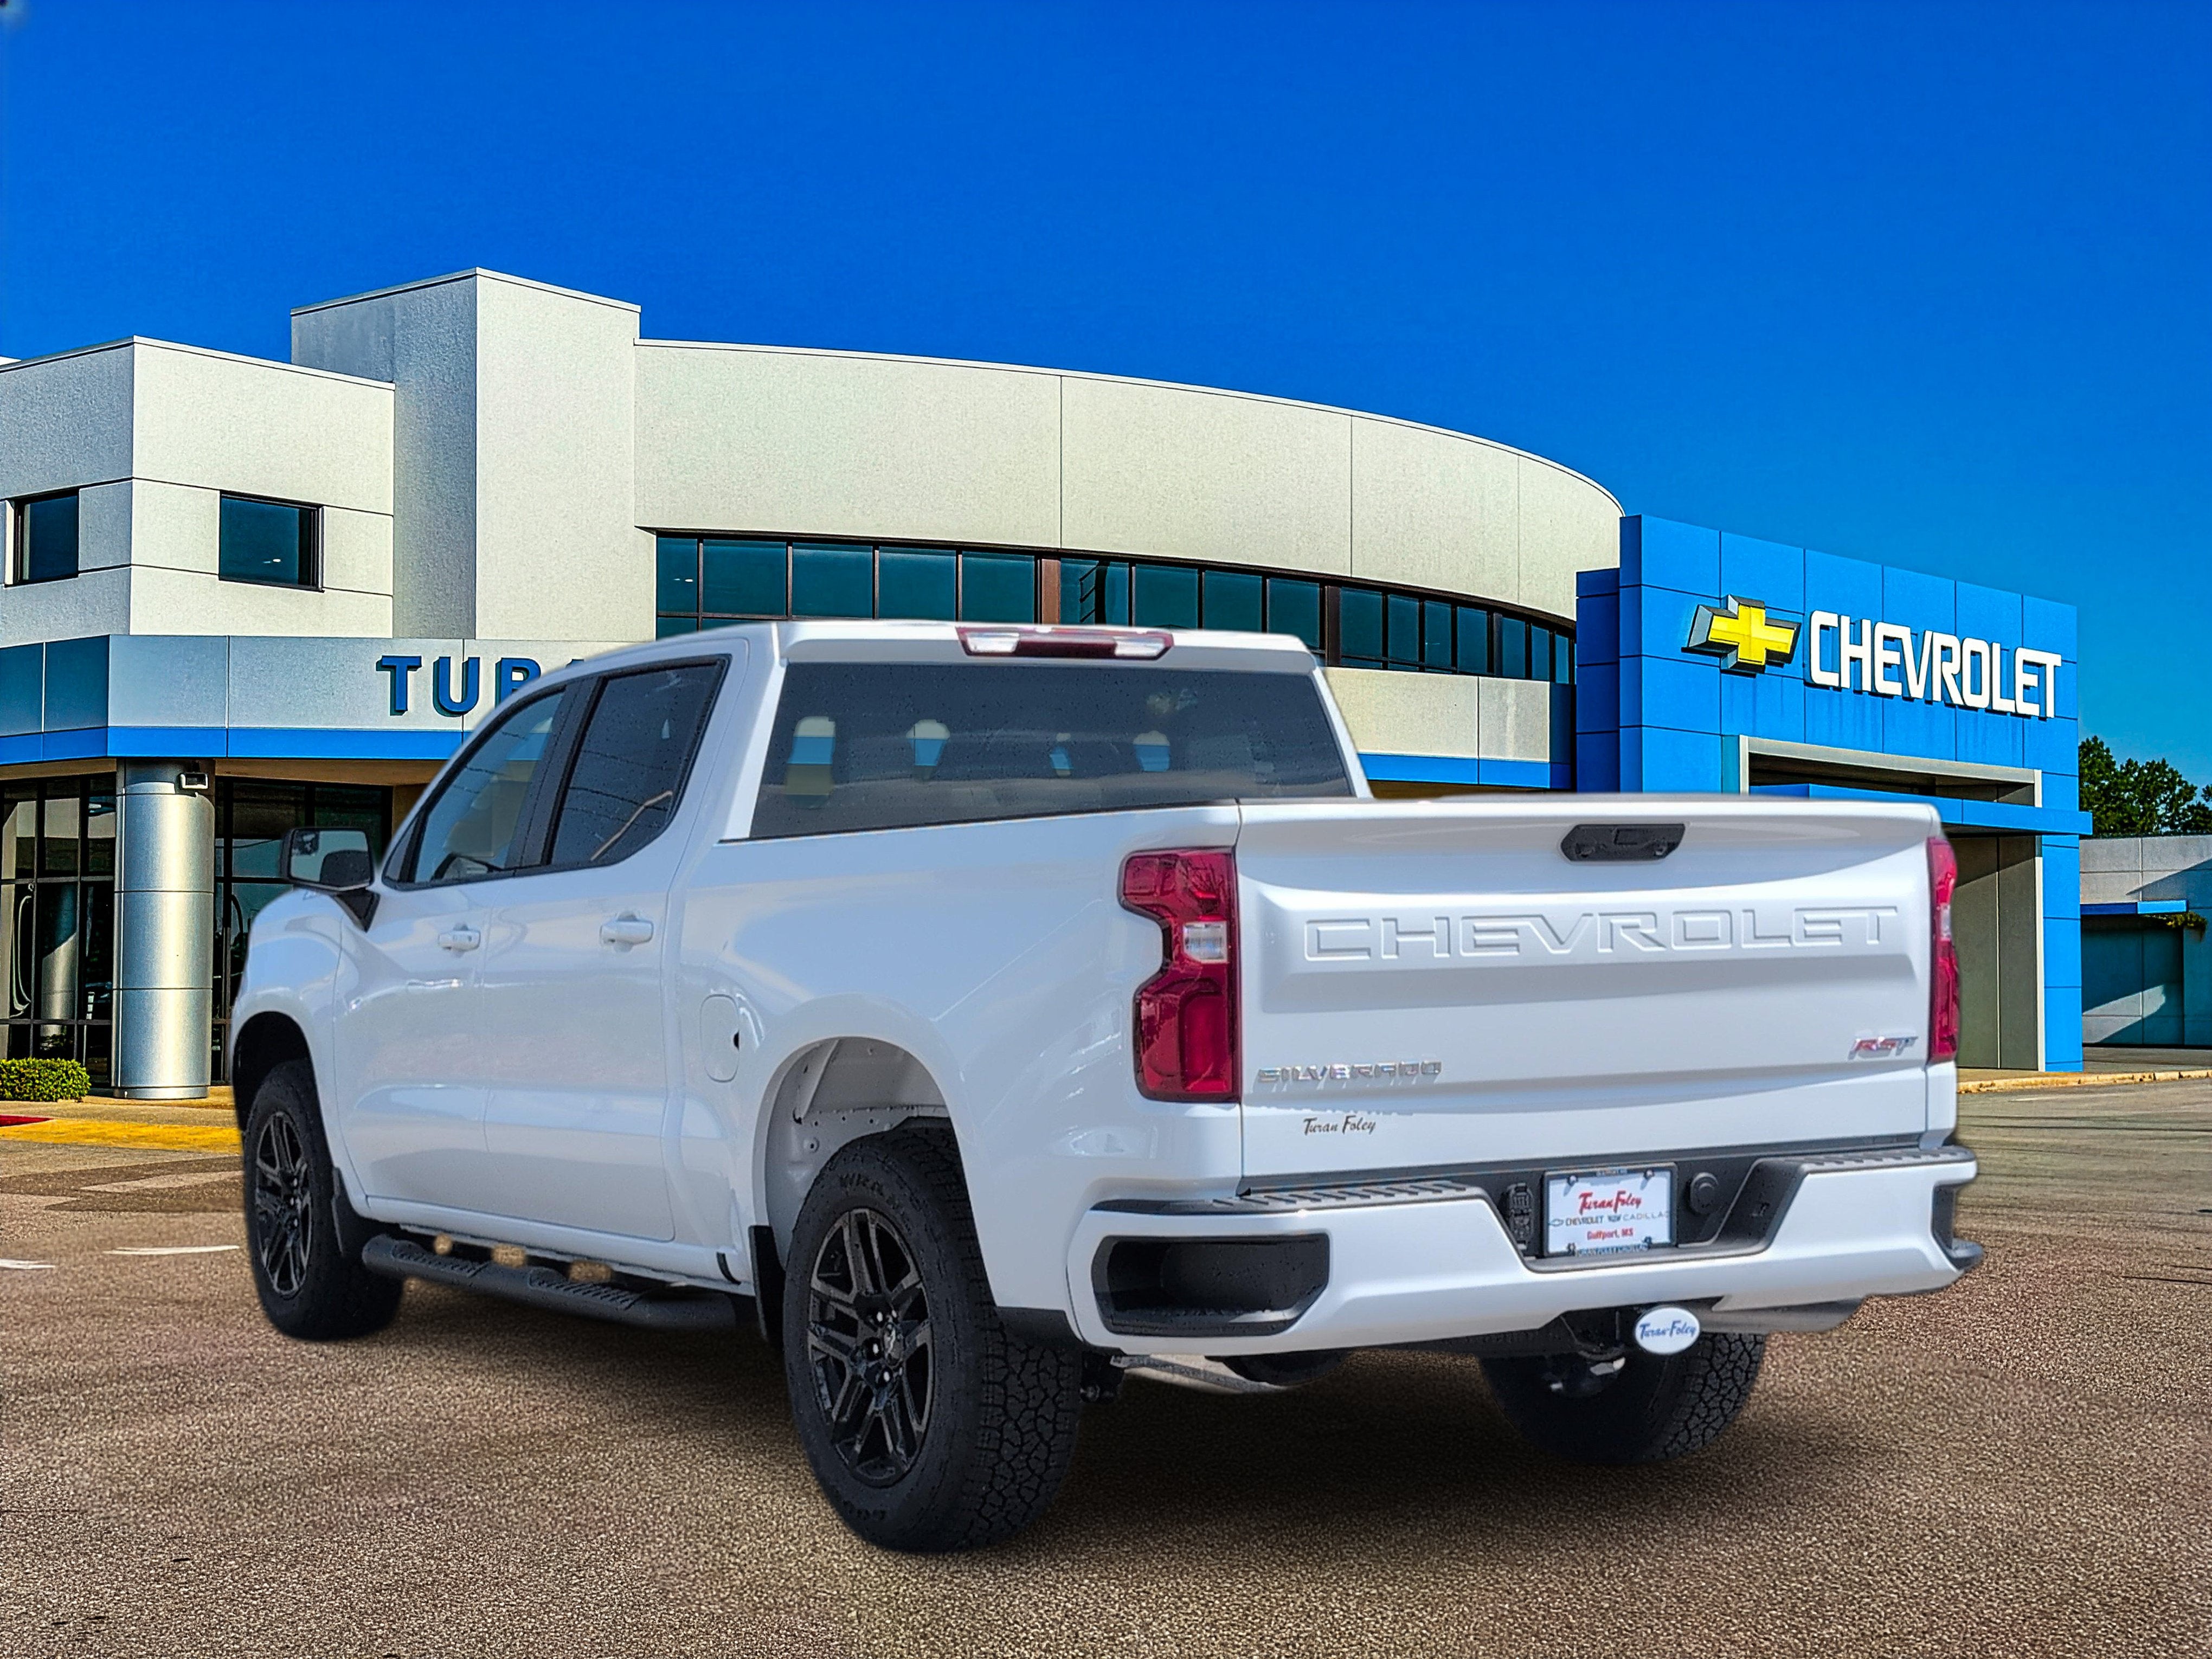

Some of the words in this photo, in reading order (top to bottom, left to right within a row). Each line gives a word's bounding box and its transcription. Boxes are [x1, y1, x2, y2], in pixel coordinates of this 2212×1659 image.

[1810, 610, 2062, 718] CHEVROLET
[376, 655, 584, 716] TUR
[1303, 906, 1898, 961] CHEVROLET
[1257, 1060, 1442, 1083] SILVERADO
[1303, 1117, 1338, 1135] Turan
[1342, 1115, 1376, 1134] Foley
[1579, 1192, 1613, 1215] Turan
[1613, 1190, 1642, 1213] Foley
[1622, 1227, 1633, 1237] MS
[1669, 1321, 1696, 1338] Foley
